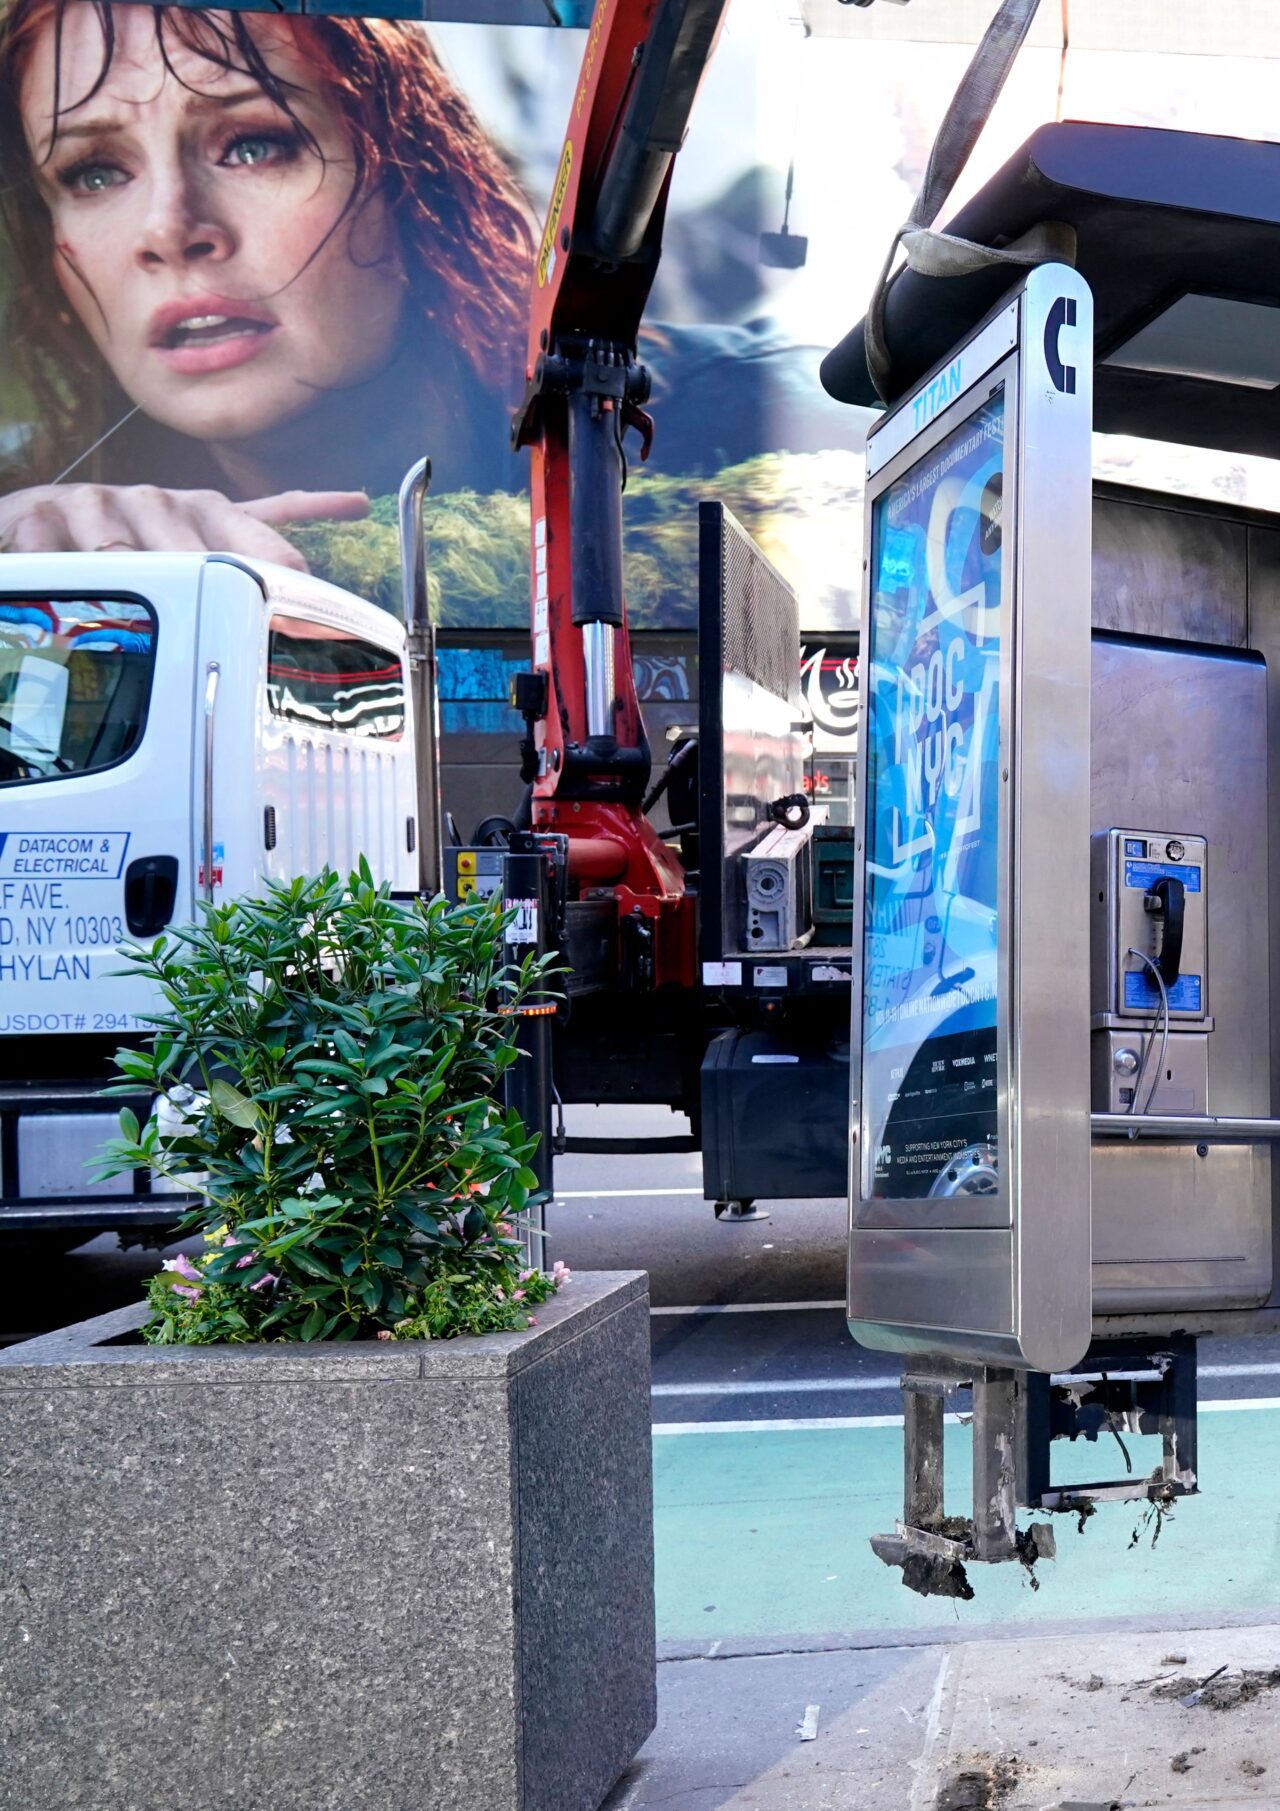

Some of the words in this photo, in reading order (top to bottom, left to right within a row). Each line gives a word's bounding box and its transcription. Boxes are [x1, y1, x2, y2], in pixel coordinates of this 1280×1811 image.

[913, 359, 961, 432] TITAN
[916, 464, 940, 497] LARGEST
[940, 428, 983, 477] DOCUMENTARY
[909, 637, 965, 735] DOC
[906, 721, 965, 817] NYC
[18, 838, 93, 853] DATACOM
[99, 838, 110, 853] &
[13, 858, 109, 873] ELECTRICAL
[0, 883, 15, 909] F
[20, 883, 70, 909] AVE.
[0, 917, 20, 947] D,
[27, 917, 57, 945] NY
[64, 916, 124, 945] 10303
[0, 954, 91, 981] HYLAN
[0, 1013, 87, 1031] USDOT#
[904, 1141, 930, 1153] SUPPORTING
[930, 1141, 941, 1151] NEW
[940, 1140, 953, 1150] YORK
[917, 1152, 953, 1163] ENTERTAINMENT
